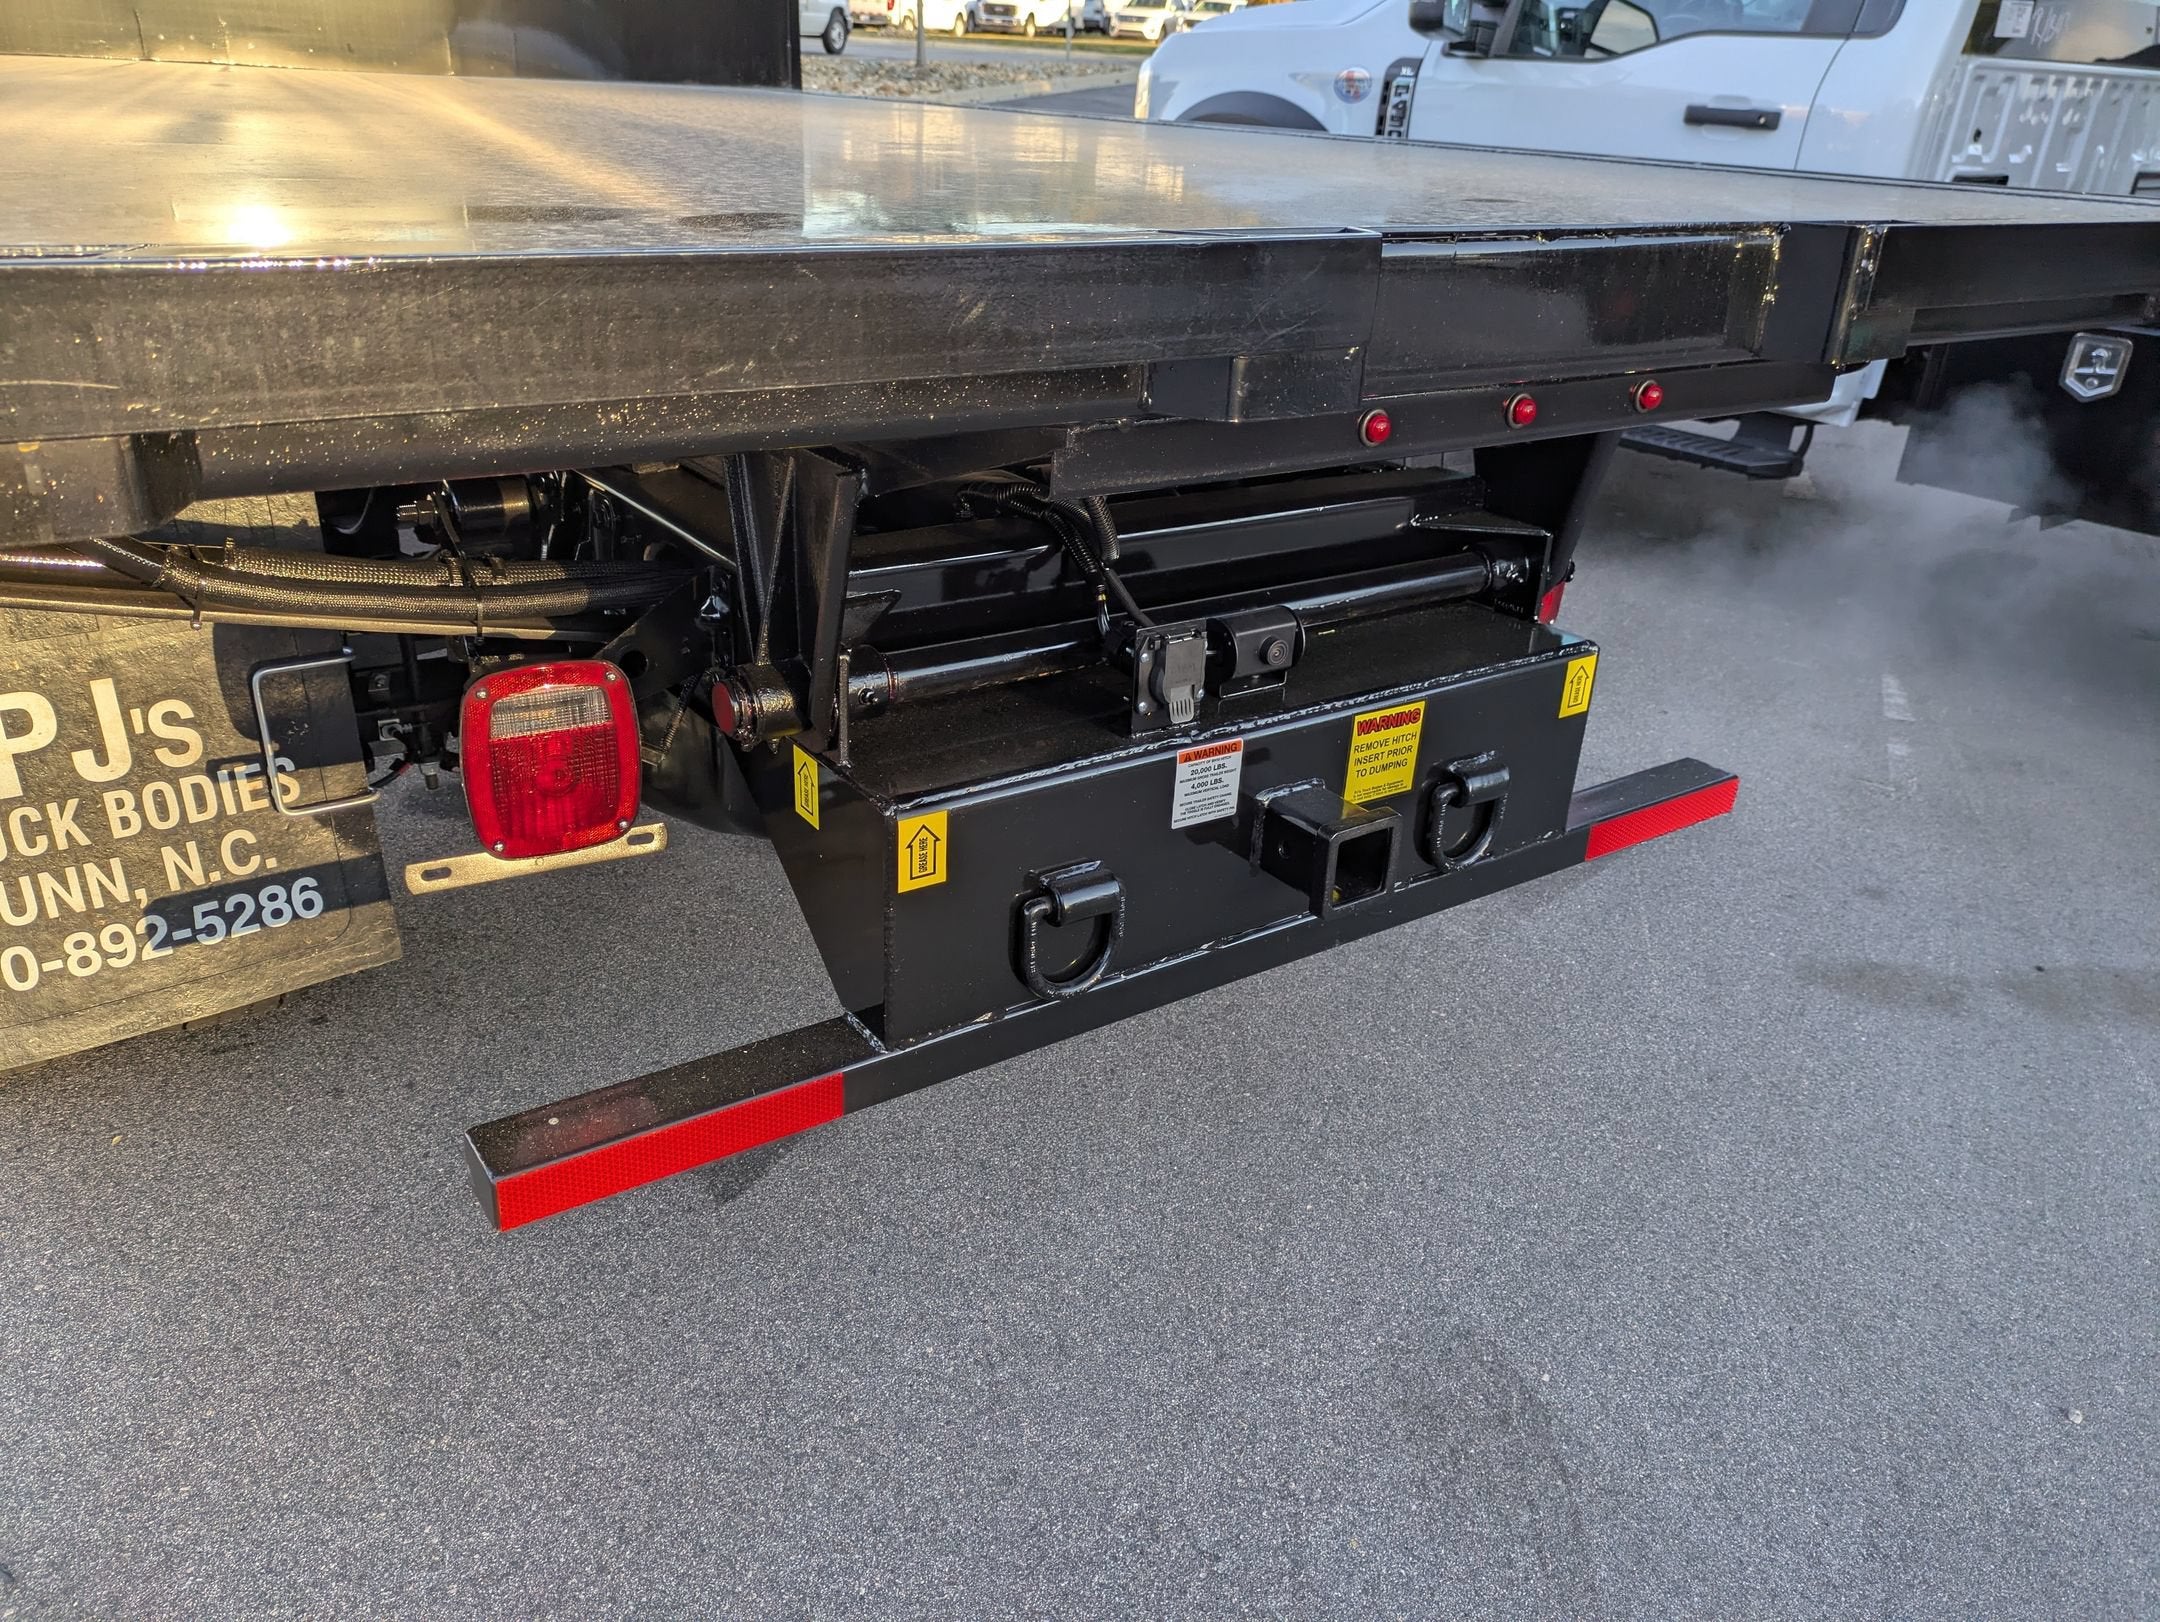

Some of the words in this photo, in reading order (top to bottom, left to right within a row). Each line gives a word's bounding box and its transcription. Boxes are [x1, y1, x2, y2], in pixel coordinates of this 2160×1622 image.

[1357, 707, 1421, 737] WARNING
[1194, 742, 1238, 760] WARNING
[1354, 738, 1390, 754] REMOVE
[1392, 731, 1417, 745] HITCH
[1354, 751, 1386, 767] INSERT
[1386, 744, 1414, 758] PRIOR
[1190, 766, 1211, 775] 20,000
[1356, 767, 1368, 778] TO
[1369, 758, 1408, 775] DUMPING
[1190, 781, 1208, 789] 4,000
[0, 798, 91, 862] CK
[102, 757, 300, 839] BODIES
[160, 829, 277, 892] N.C.
[1, 877, 324, 992] 0-892-5286
